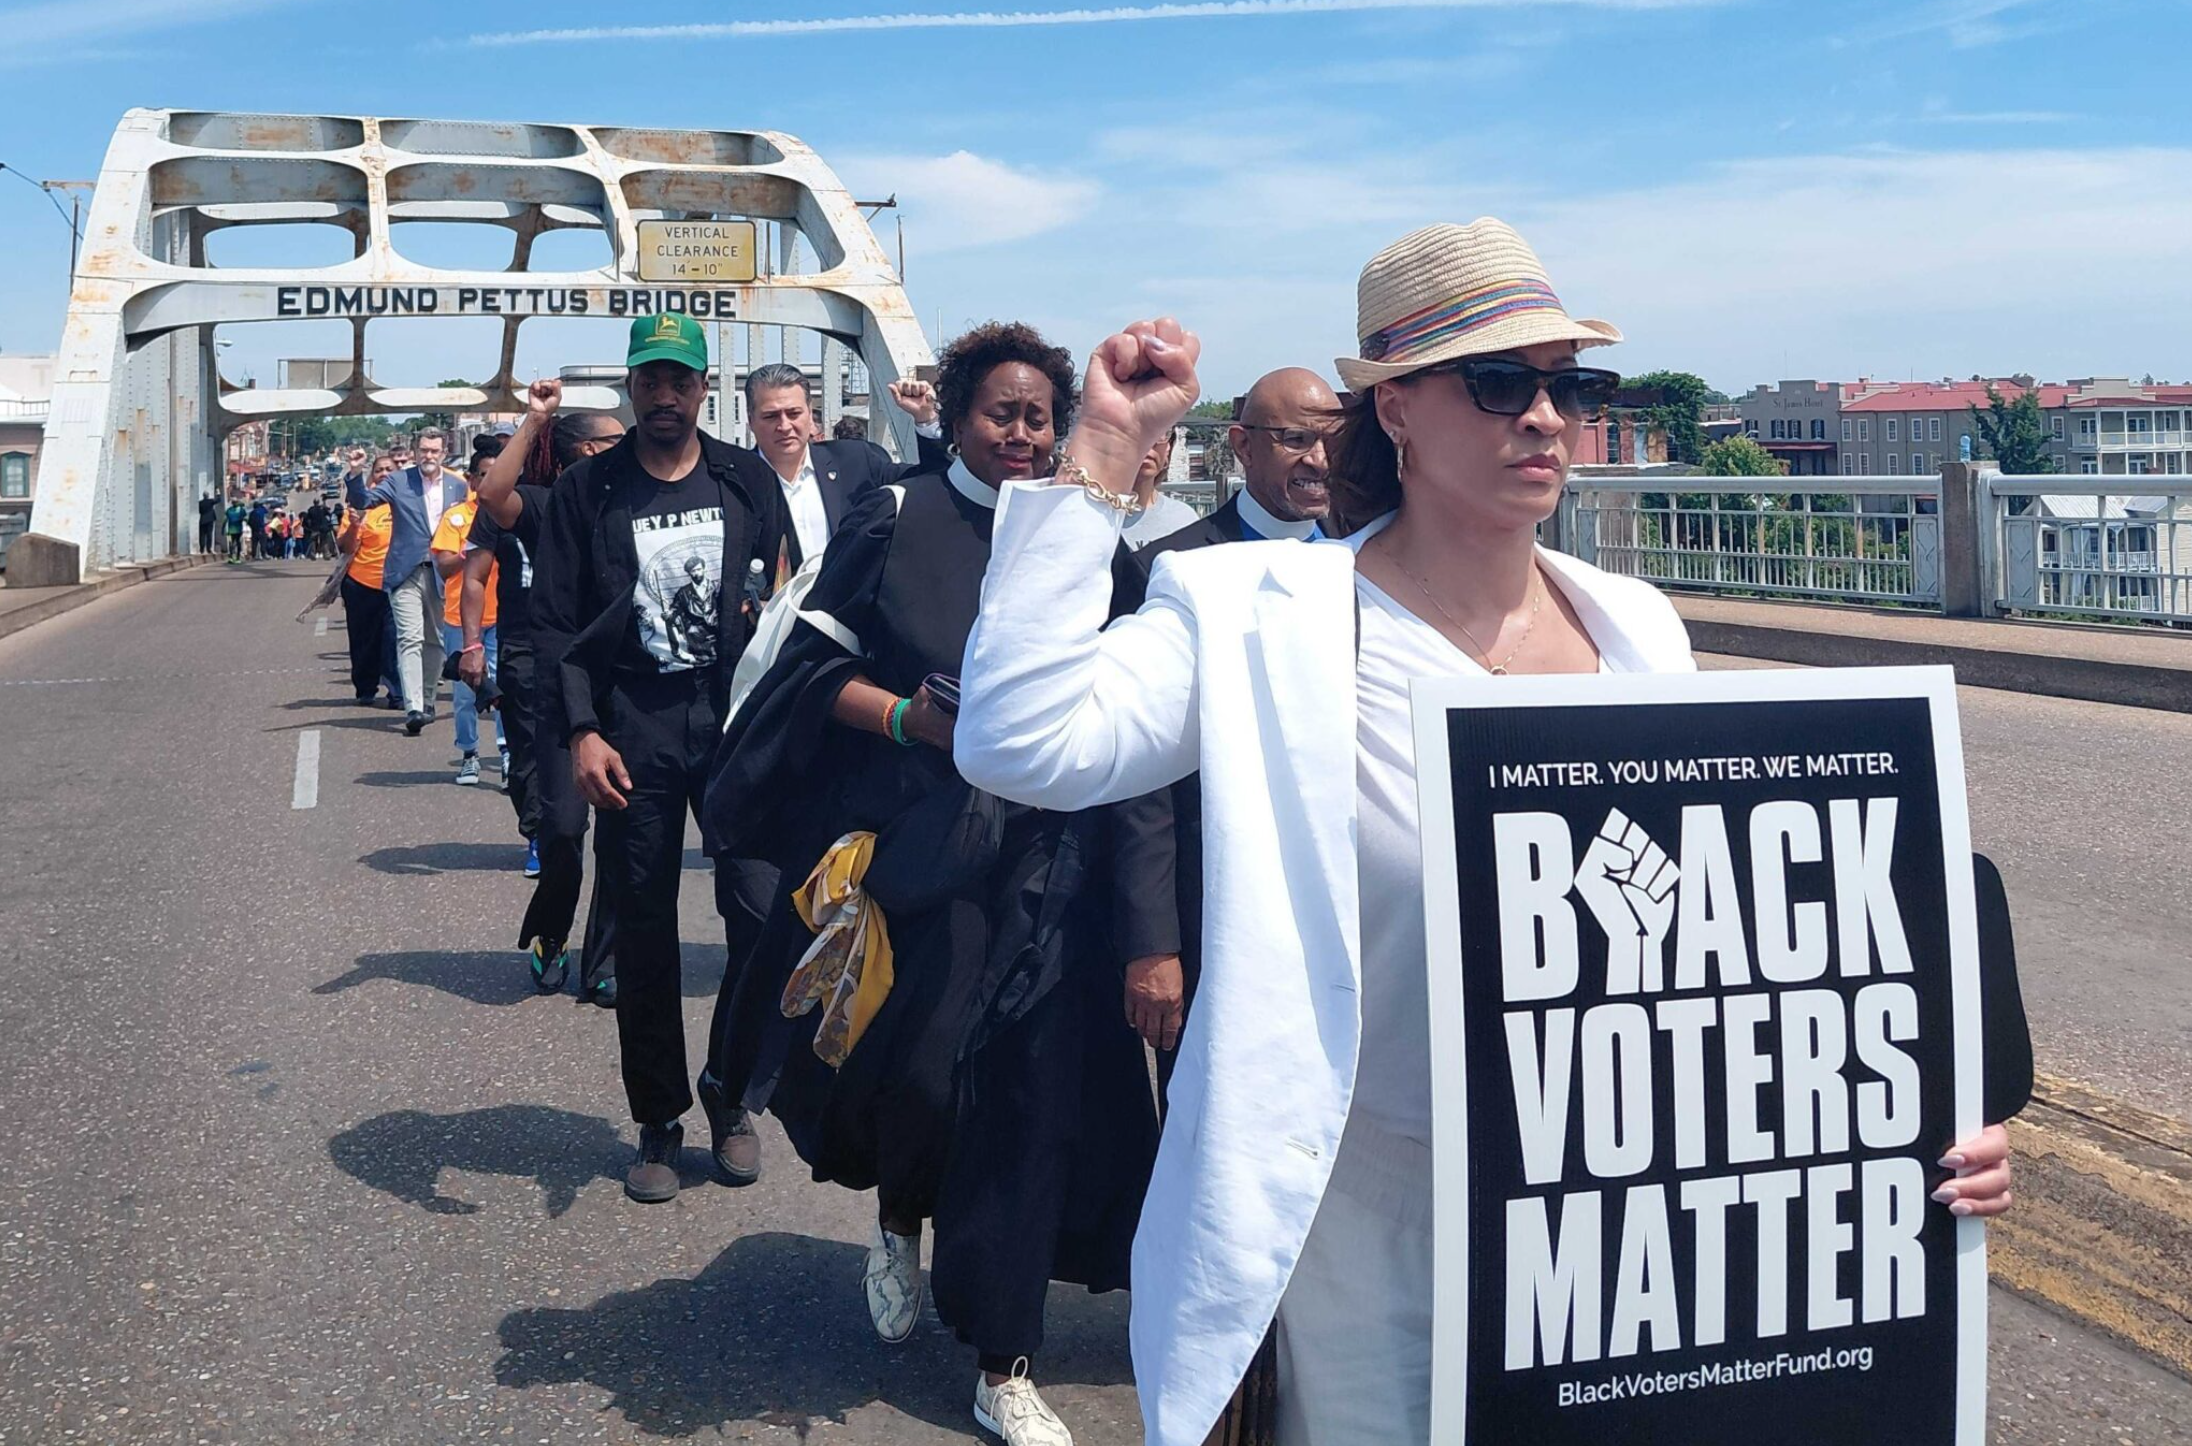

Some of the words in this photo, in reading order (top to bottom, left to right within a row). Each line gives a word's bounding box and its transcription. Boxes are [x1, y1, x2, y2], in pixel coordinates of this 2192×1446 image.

[664, 226, 730, 239] VERTICAL
[656, 245, 739, 258] CLEARANCE
[277, 287, 438, 316] EDMUND
[458, 288, 588, 313] PETTUS
[608, 289, 737, 318] BRIDGE
[666, 513, 678, 528] P
[1489, 764, 1496, 788] I
[1502, 762, 1604, 788] MATTER.
[1607, 760, 1659, 784] YOU
[1664, 757, 1761, 782] MATTER.
[1762, 755, 1802, 778] WE
[1806, 752, 1900, 777] MATTER.
[1503, 982, 1922, 1186] VOTERS
[1504, 1156, 1927, 1372] MATTER
[1558, 1346, 1874, 1408] BlackVotersMatterFund.org
